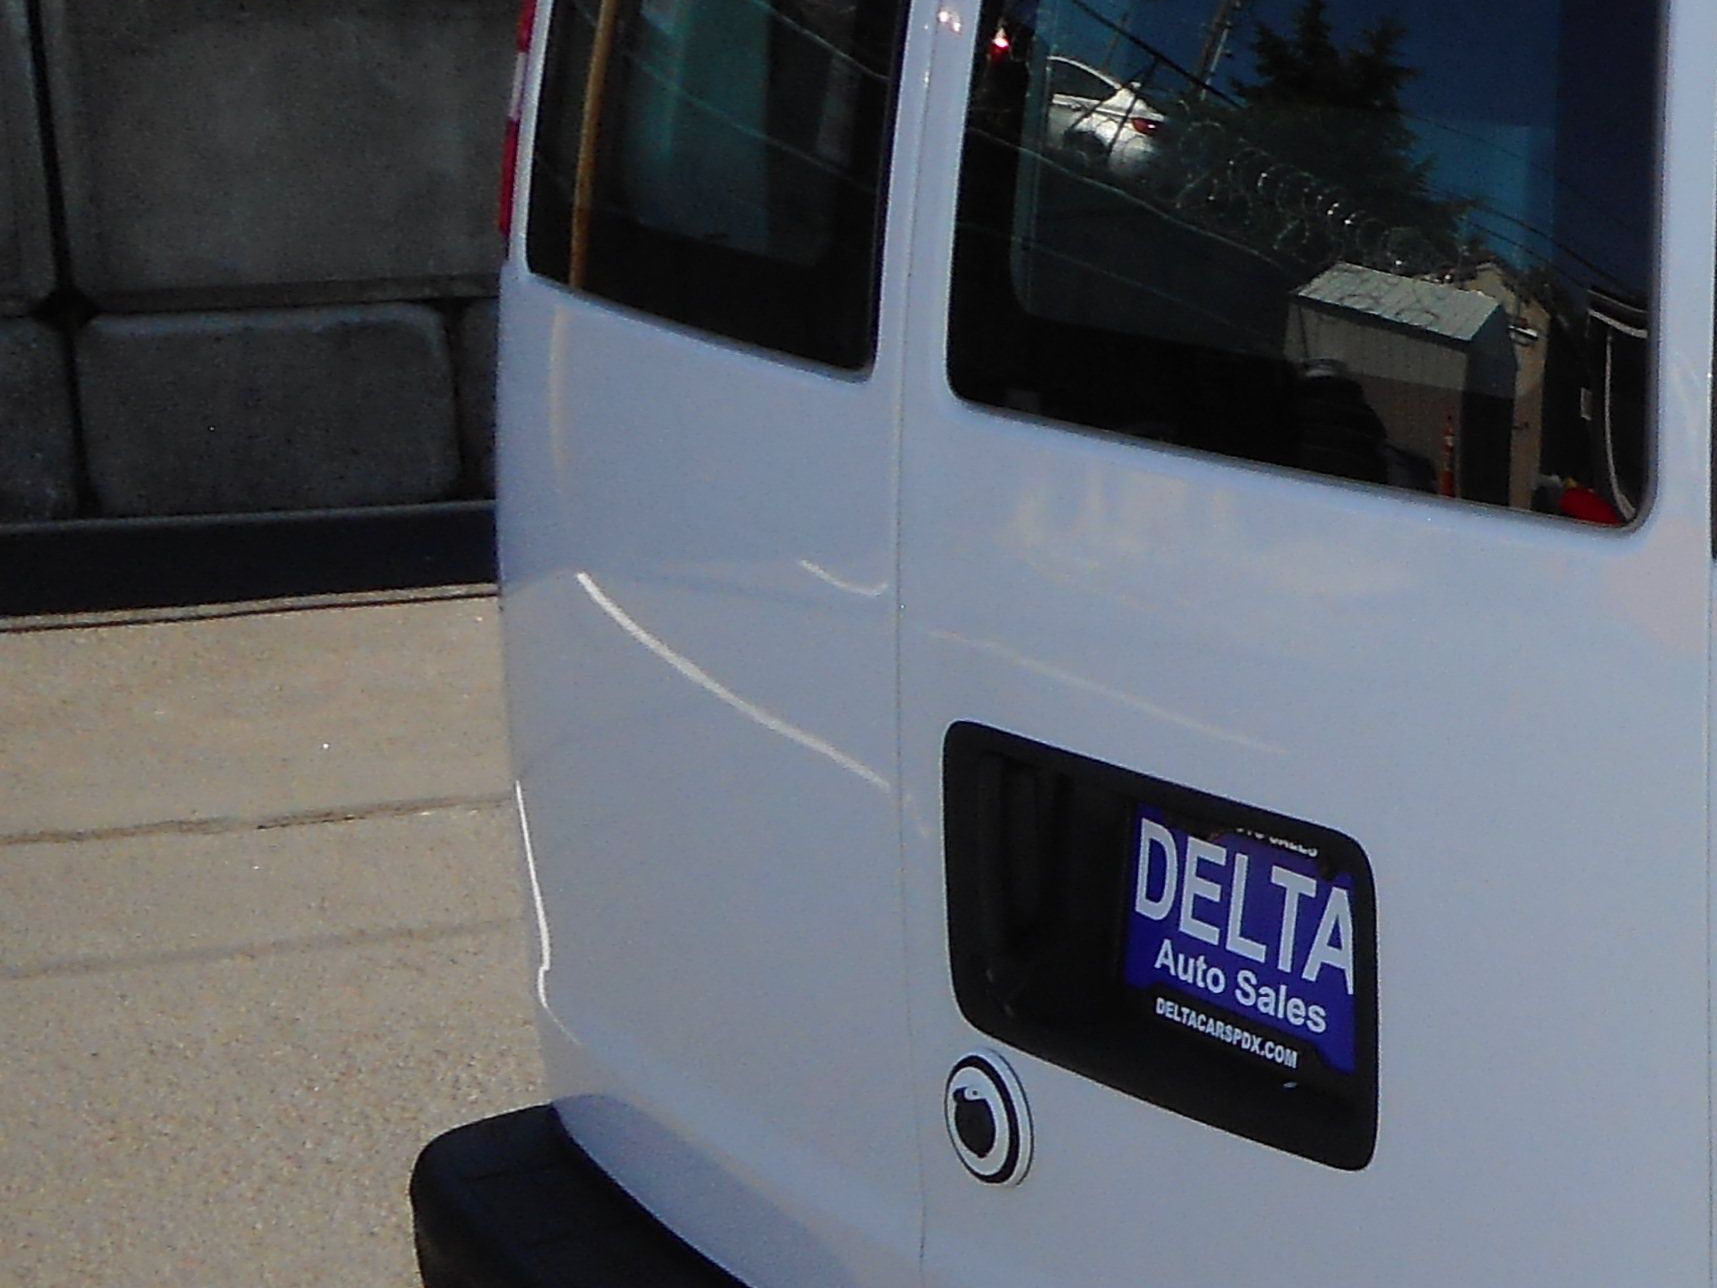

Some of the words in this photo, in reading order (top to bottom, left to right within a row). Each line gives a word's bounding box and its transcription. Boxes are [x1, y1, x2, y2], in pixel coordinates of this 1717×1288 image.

[1134, 817, 1355, 996] DELTA
[1154, 939, 1226, 995] Auto
[1235, 969, 1328, 1034] Sales
[1156, 996, 1298, 1070] DELTACARSPDX.COM
